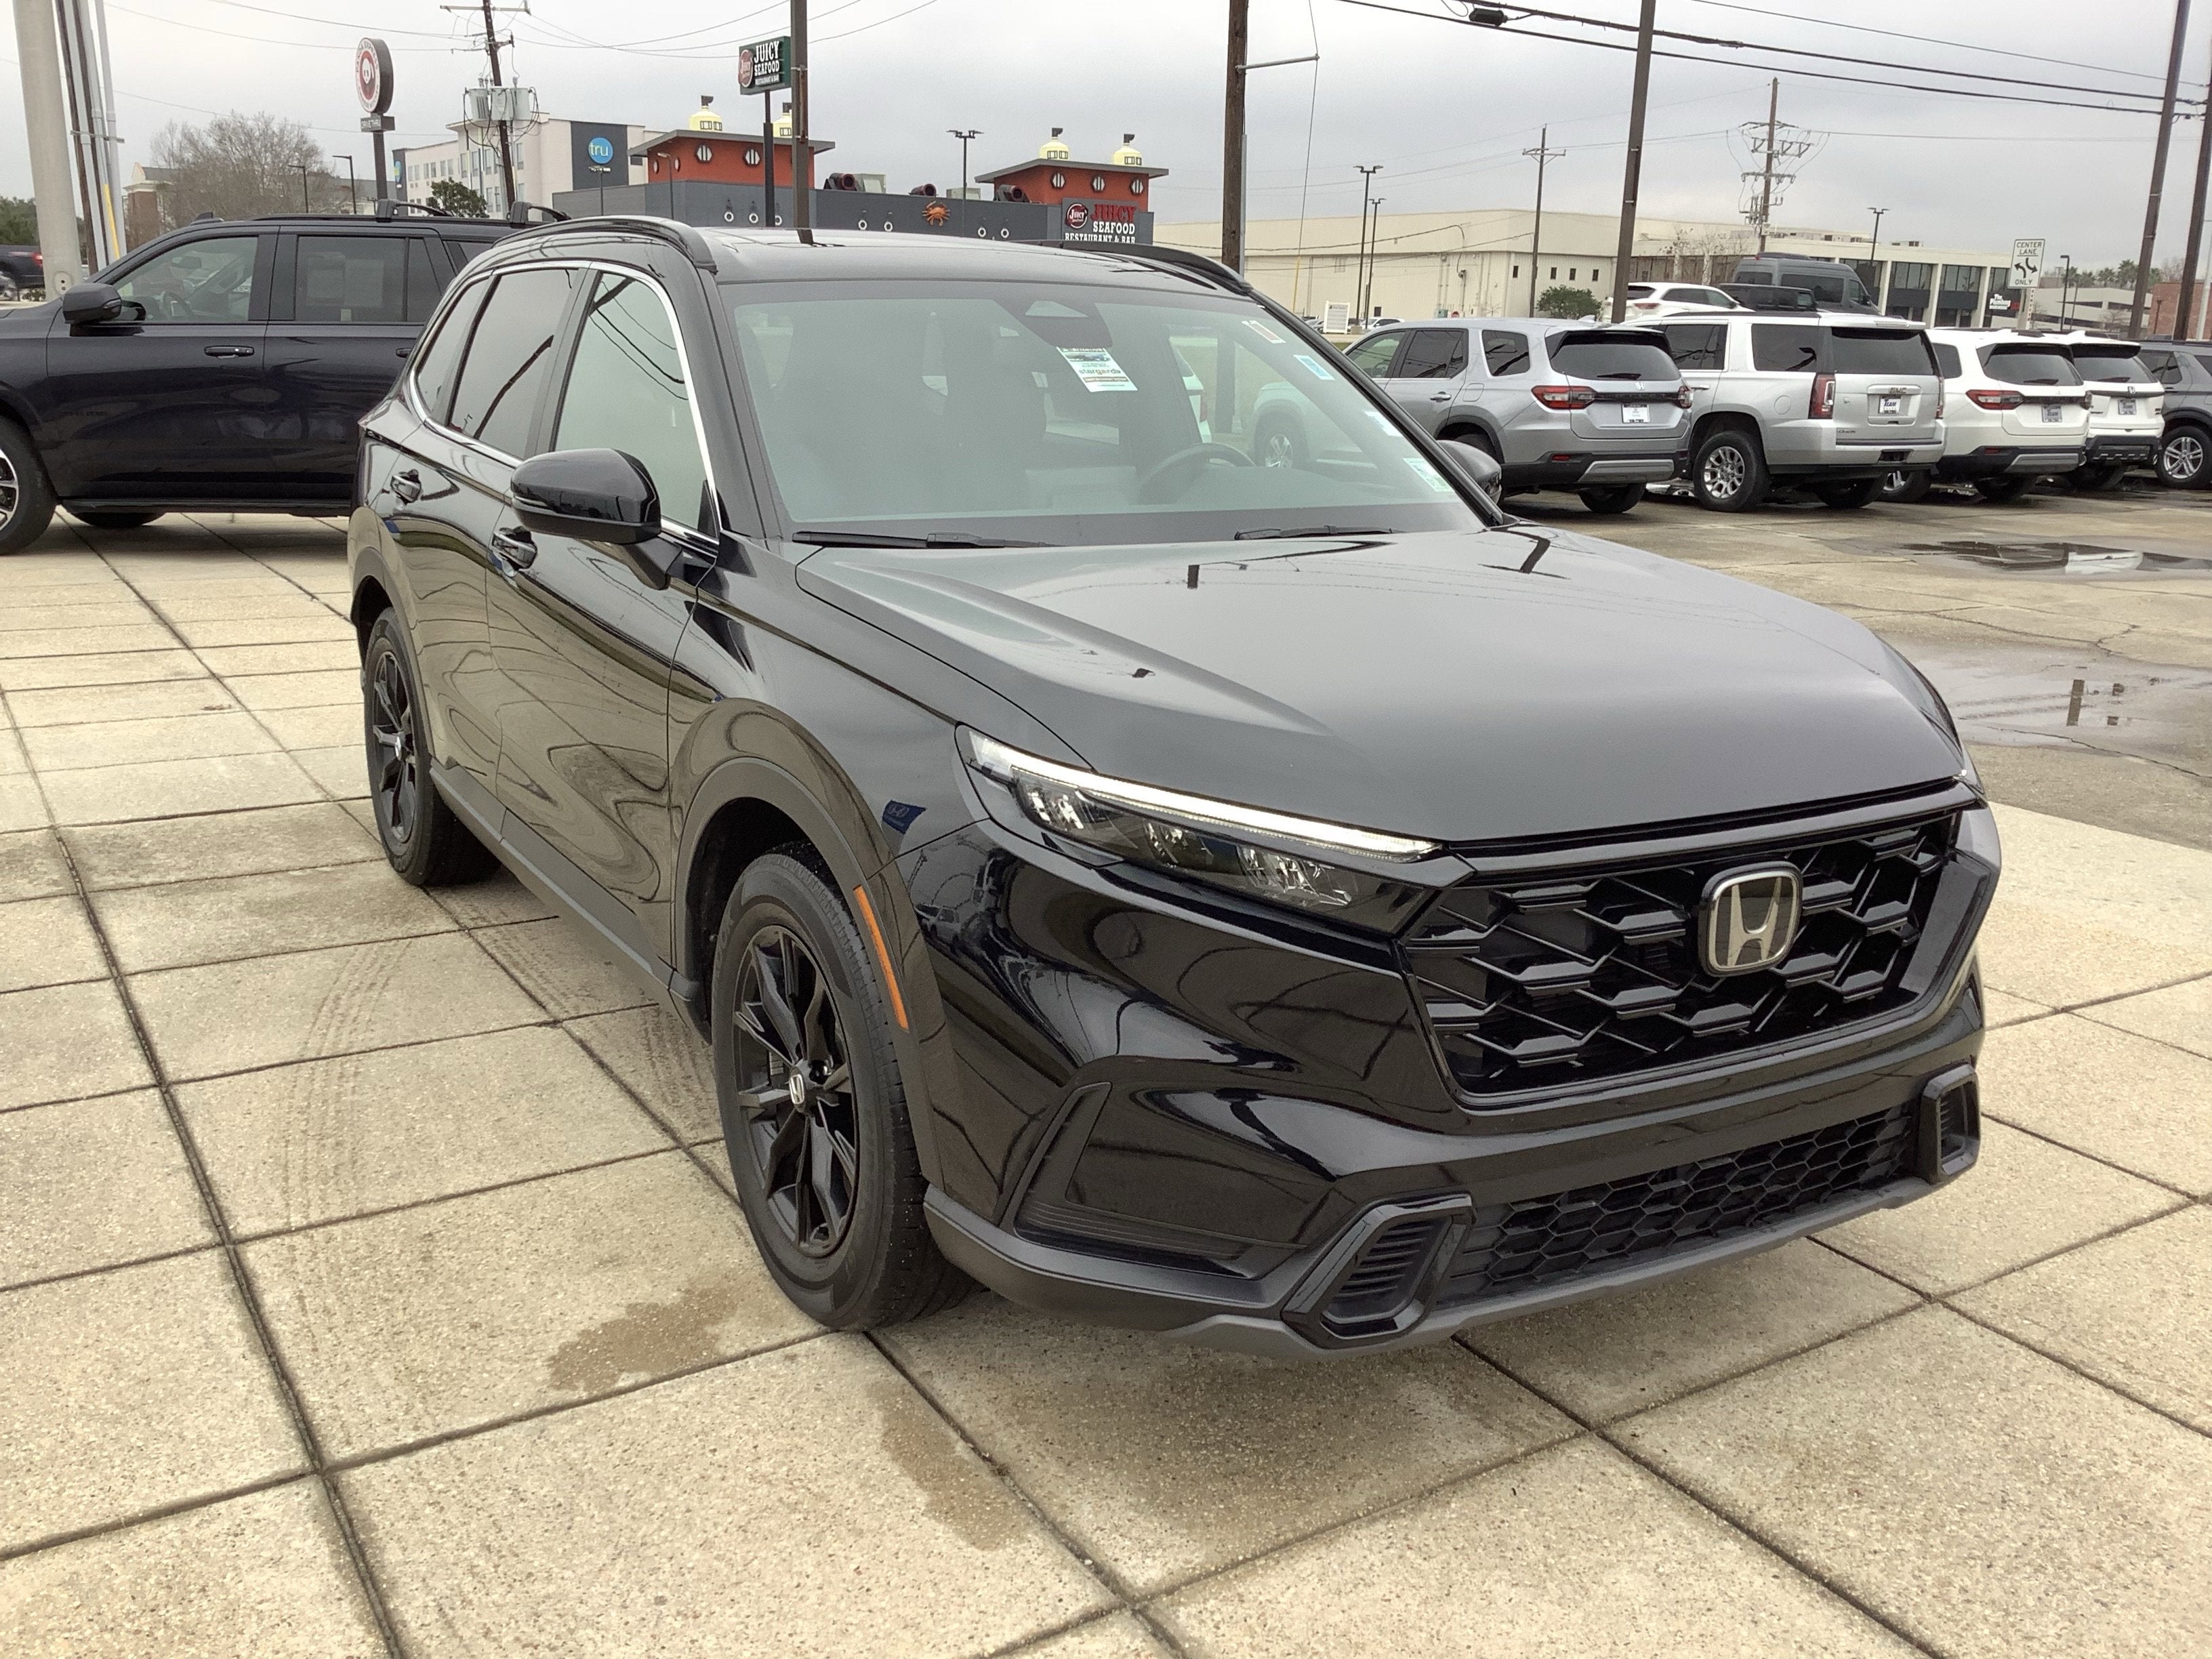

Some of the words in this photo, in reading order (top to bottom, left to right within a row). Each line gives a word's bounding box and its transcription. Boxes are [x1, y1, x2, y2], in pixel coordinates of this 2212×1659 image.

[754, 41, 779, 63] JUICY
[754, 60, 779, 76] SEAFOOD
[590, 142, 608, 157] tru
[1091, 204, 1136, 223] JUICY
[1093, 221, 1135, 234] SEAFOOD
[1065, 232, 1112, 242] RESTAURANT
[1122, 236, 1135, 244] BAR
[1884, 398, 1897, 407] TEAM
